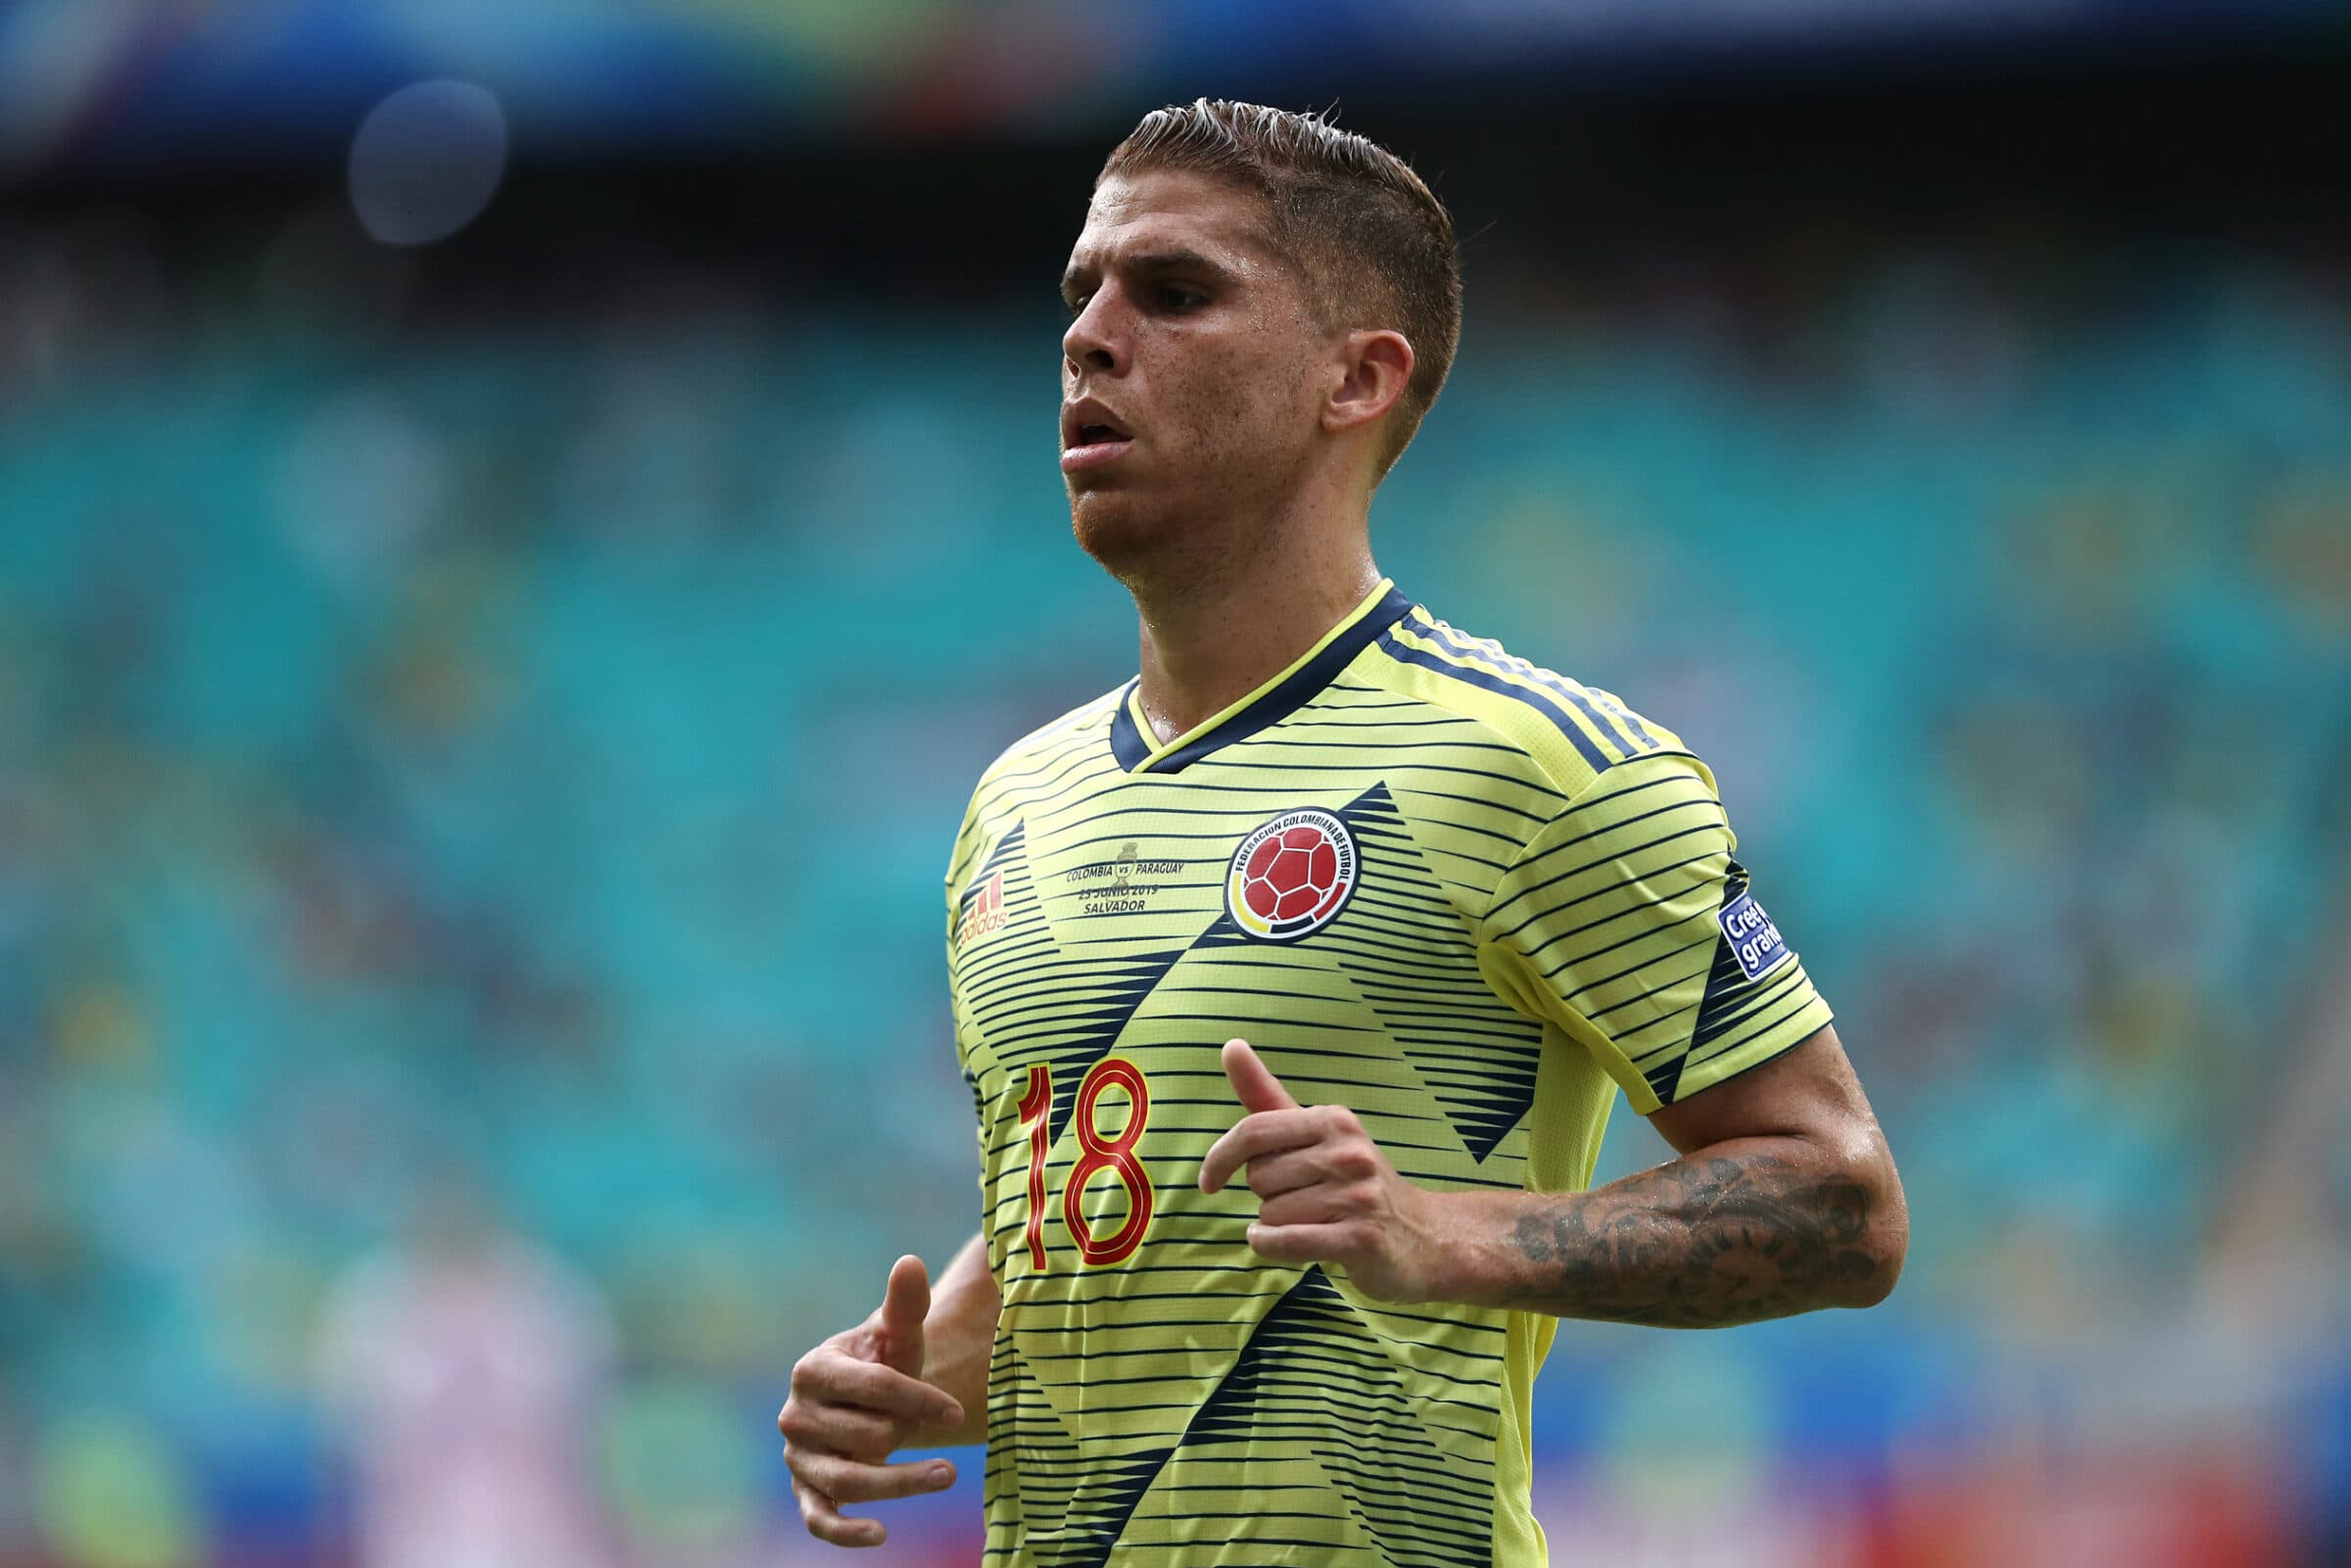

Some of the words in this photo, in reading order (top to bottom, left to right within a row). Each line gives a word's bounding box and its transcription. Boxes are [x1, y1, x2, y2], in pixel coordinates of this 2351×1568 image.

[1235, 822, 1281, 872] FEDERACION
[1283, 814, 1335, 836] COLOMBIANA
[1333, 832, 1345, 846] DE
[1339, 844, 1352, 880] FUTBOL
[1066, 866, 1113, 882] COLOMBIA
[1135, 863, 1184, 875] PARAGUAY
[1094, 885, 1129, 898] JUNIO
[1131, 884, 1160, 895] 2019
[1083, 900, 1145, 914] SALVADOR
[961, 911, 1008, 945] adidas
[1017, 1055, 1156, 1274] 18
